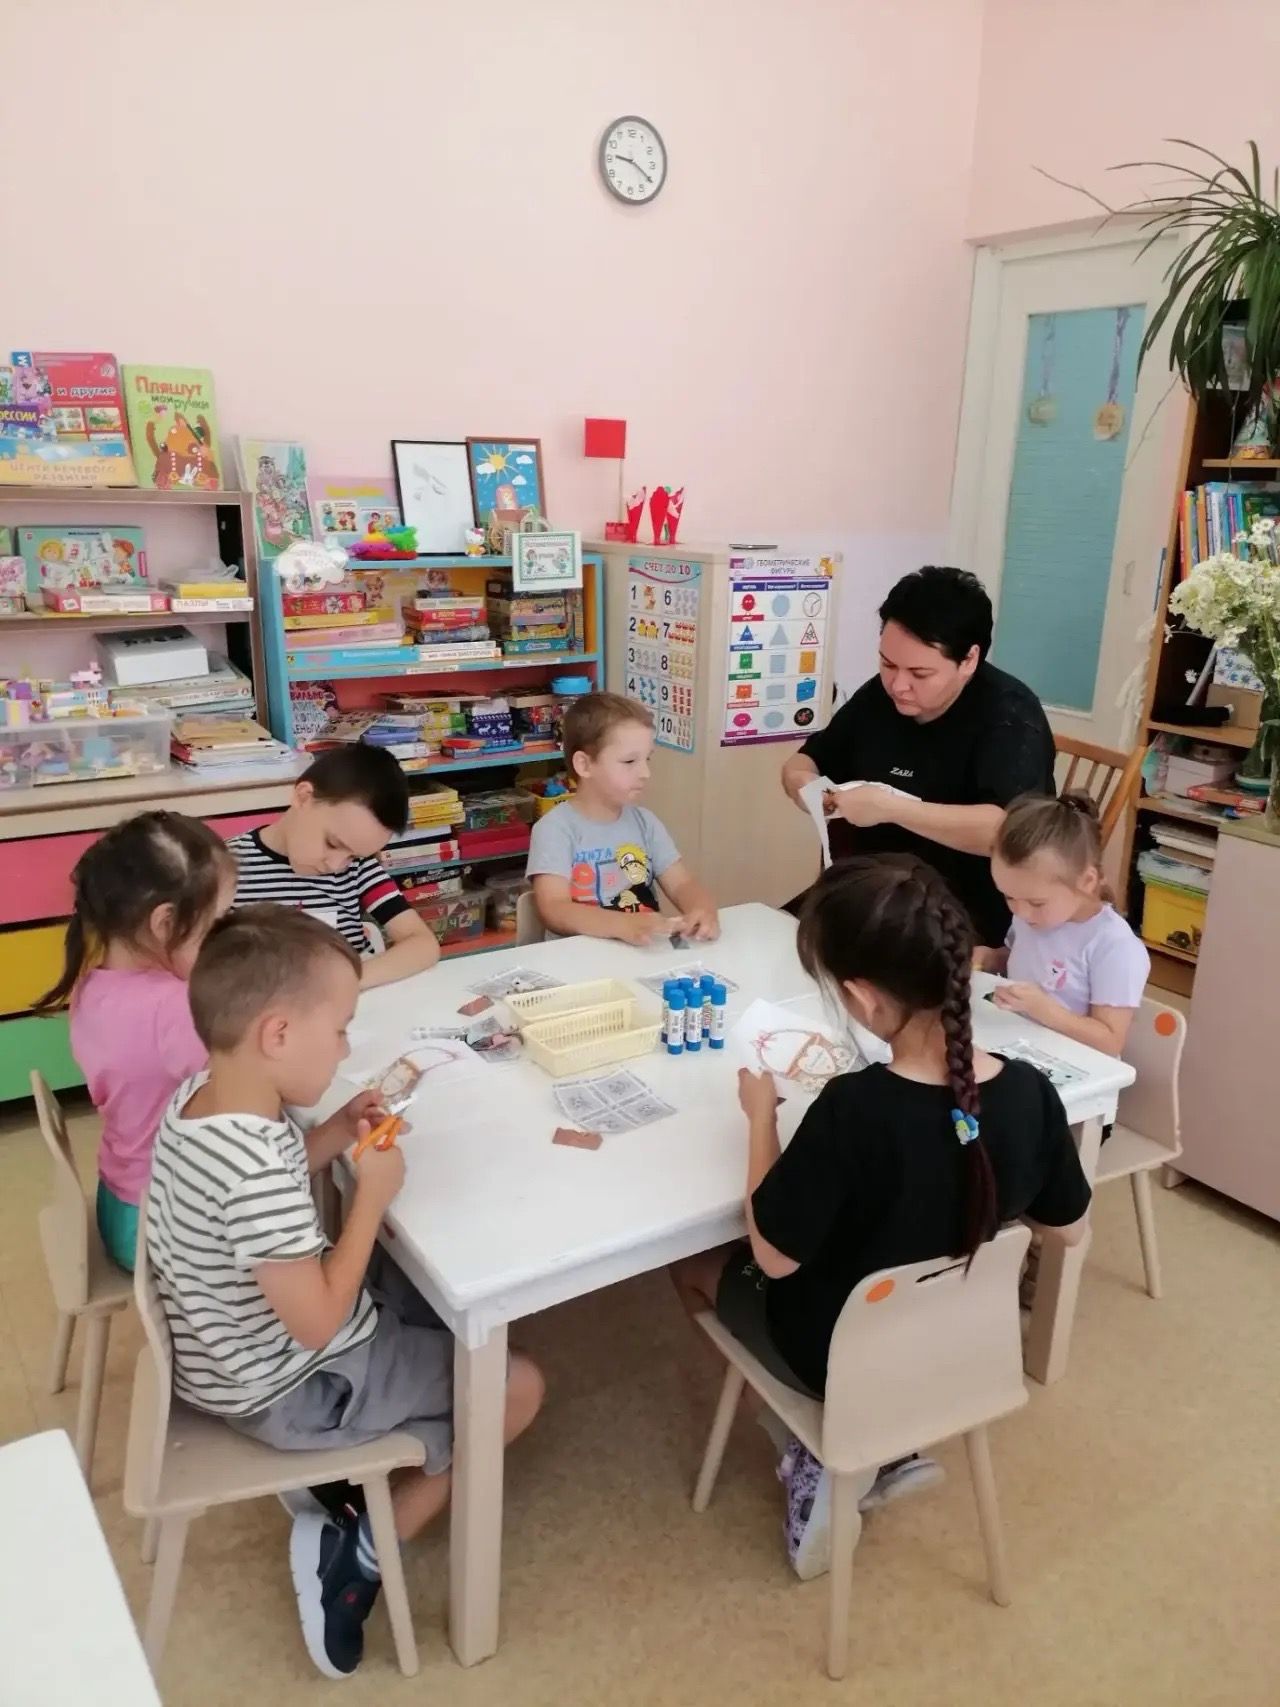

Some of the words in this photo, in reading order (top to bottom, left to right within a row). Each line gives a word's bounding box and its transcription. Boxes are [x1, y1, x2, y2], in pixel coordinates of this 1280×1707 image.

[679, 564, 692, 576] 10
[631, 585, 637, 600] 1
[664, 589, 672, 606] 6
[629, 616, 636, 632] 2
[663, 622, 671, 638] 7
[628, 647, 635, 662] 3
[661, 654, 668, 671] 8
[628, 678, 636, 692] 4
[661, 685, 669, 701] 9
[661, 717, 673, 733] 10
[890, 766, 914, 778] ZARA
